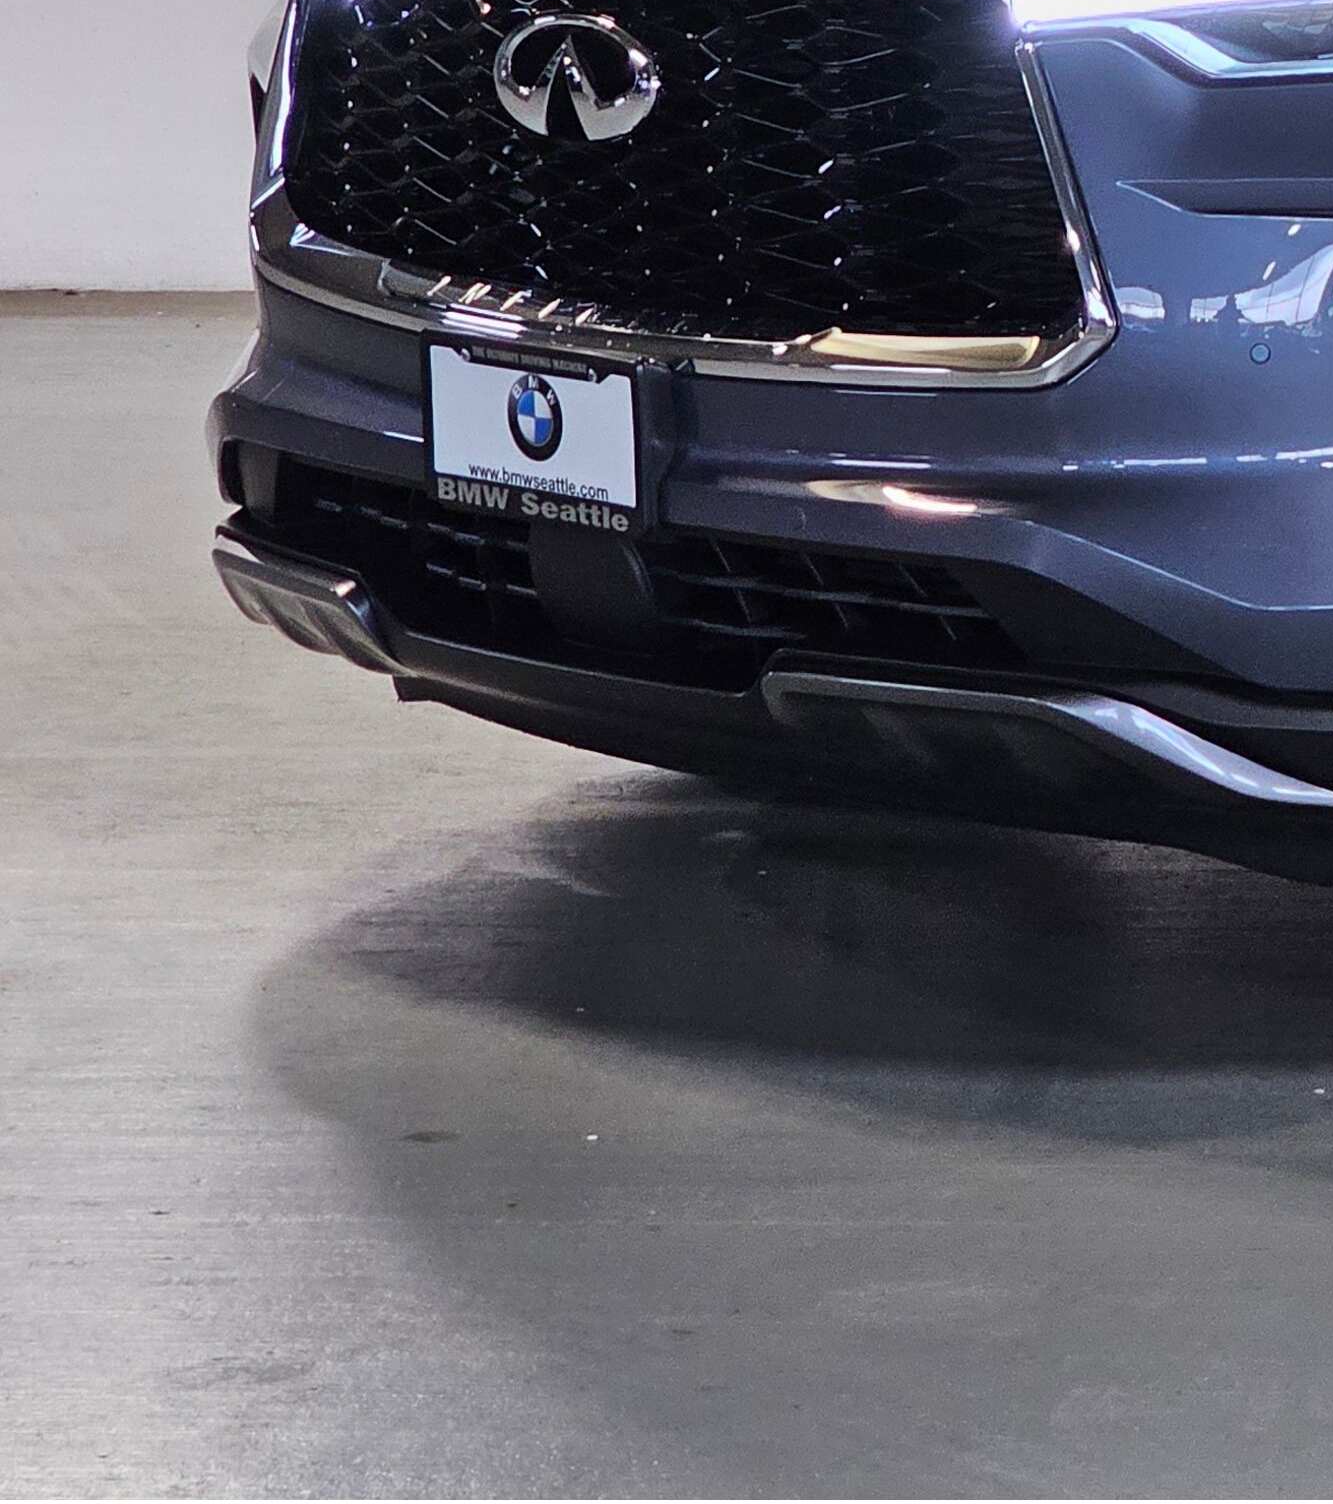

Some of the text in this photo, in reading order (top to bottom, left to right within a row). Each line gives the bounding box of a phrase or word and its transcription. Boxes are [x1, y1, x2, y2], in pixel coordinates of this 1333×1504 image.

[512, 375, 556, 406] BMW
[468, 463, 609, 501] www.bmwseattle.com
[437, 477, 629, 532] BMW Seattle
